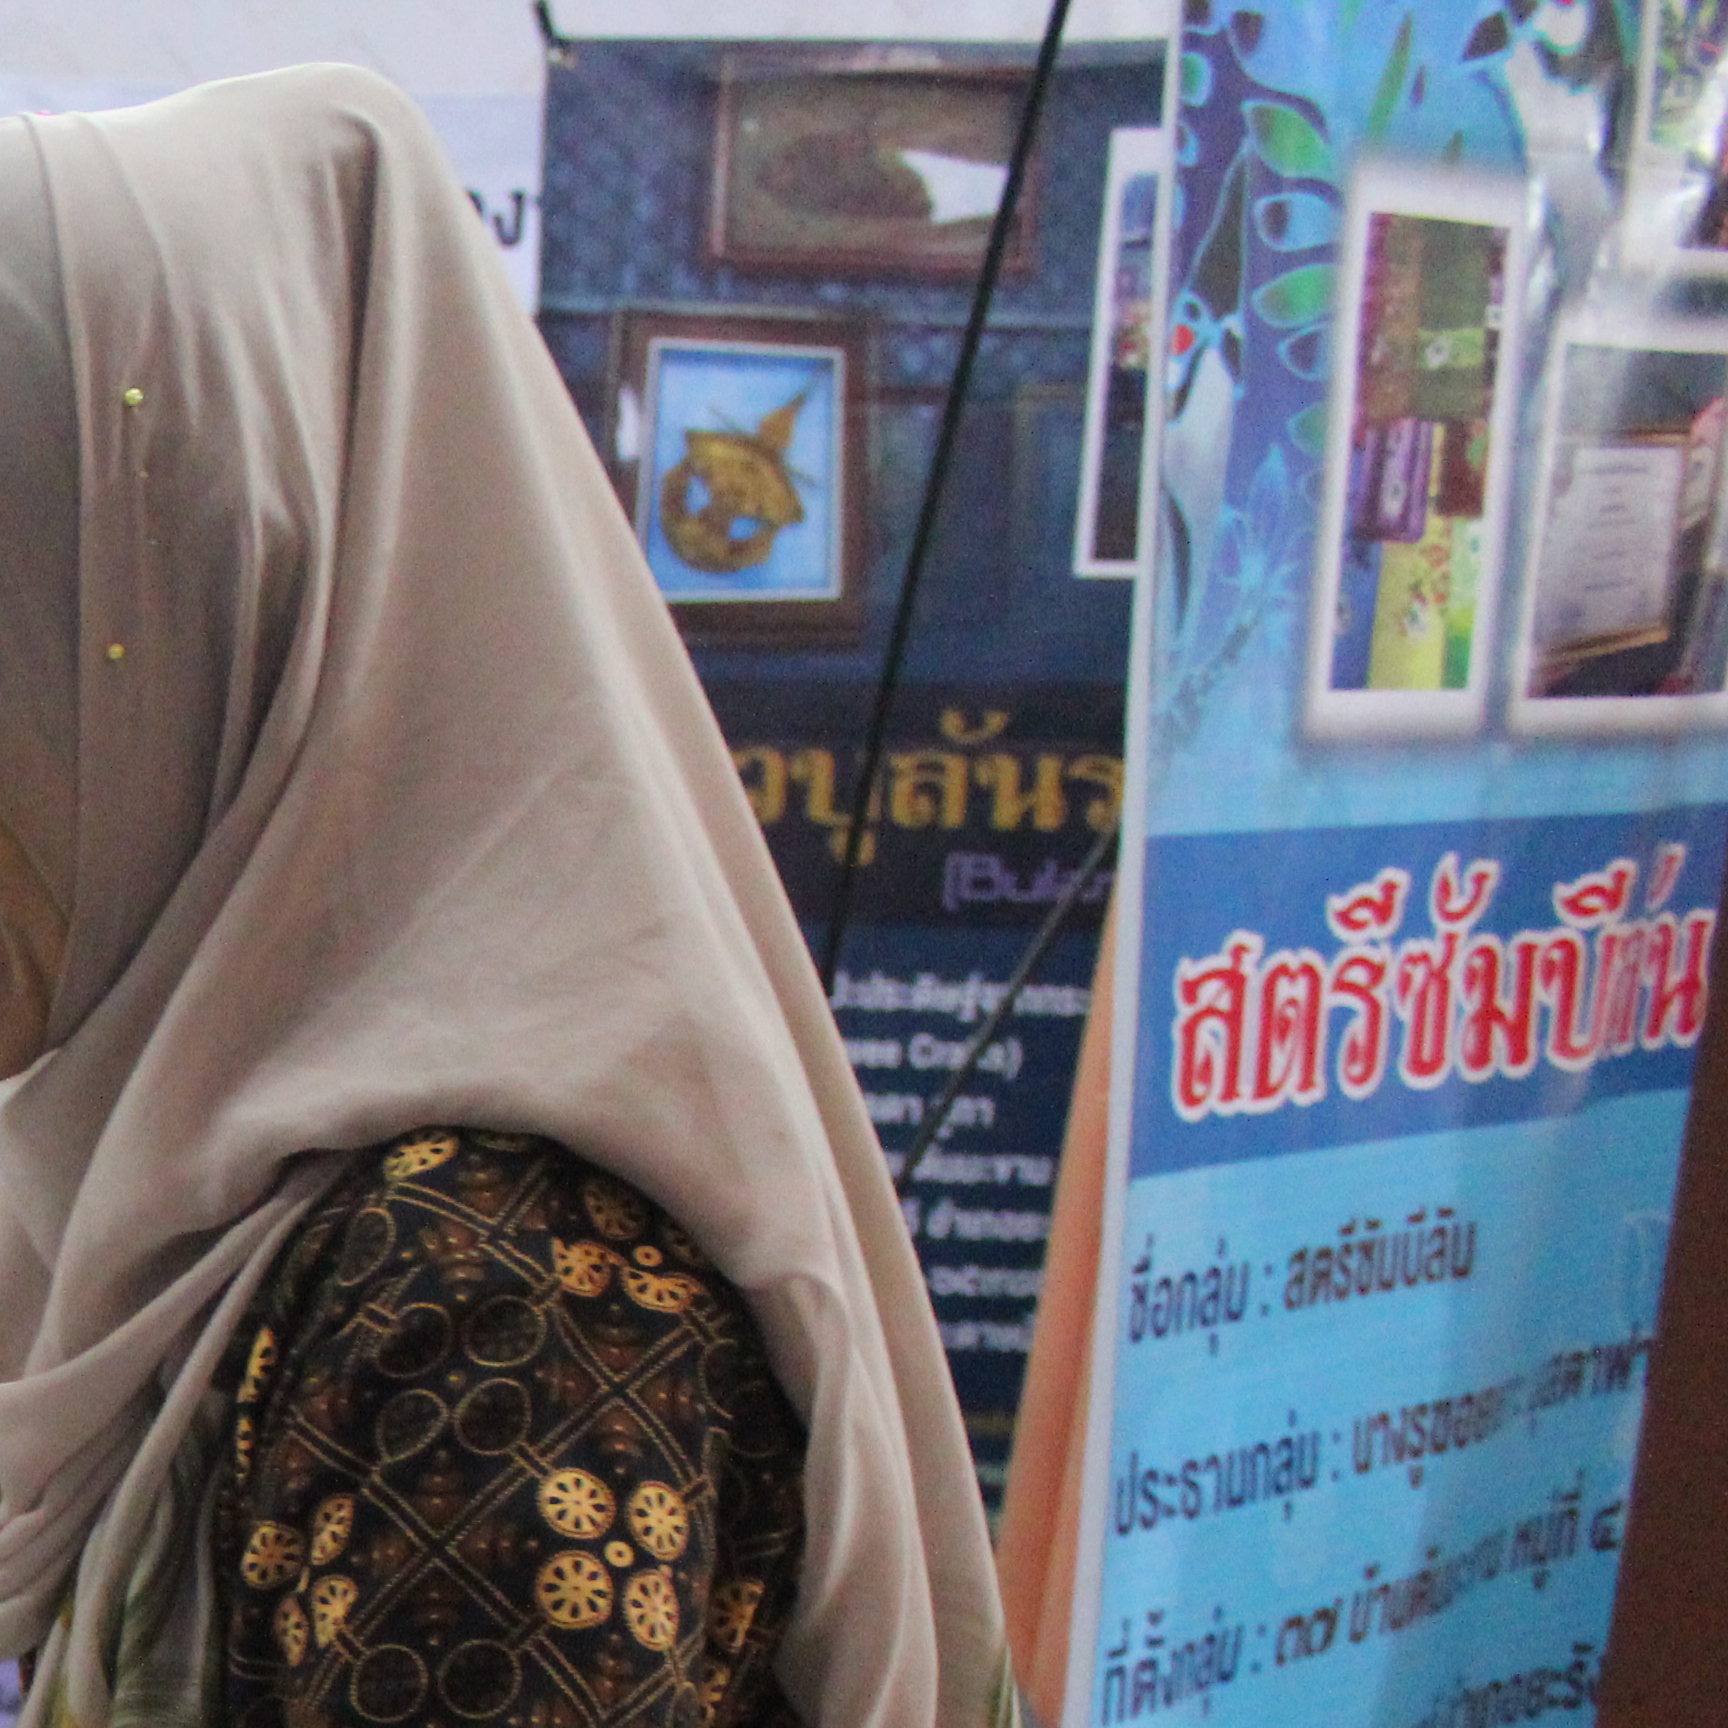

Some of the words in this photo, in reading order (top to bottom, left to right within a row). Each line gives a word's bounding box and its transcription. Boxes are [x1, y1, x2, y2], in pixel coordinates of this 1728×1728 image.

[1129, 1233, 1251, 1356] ชื่อกลุ่ม
[1114, 1408, 1323, 1538] ประธานกลุ่ม
